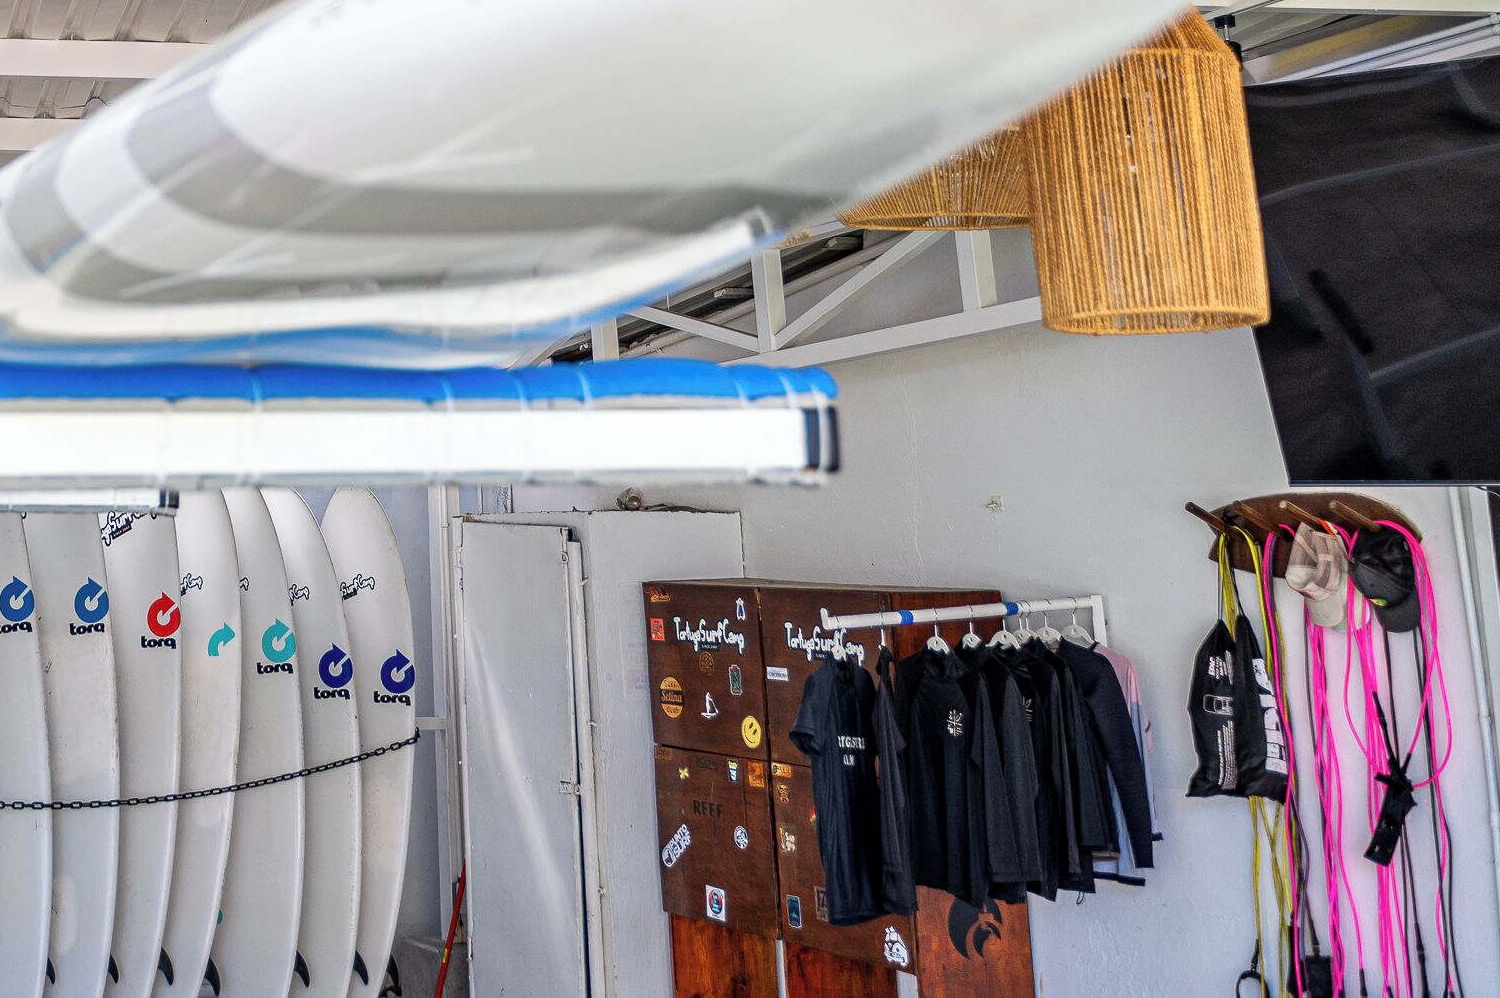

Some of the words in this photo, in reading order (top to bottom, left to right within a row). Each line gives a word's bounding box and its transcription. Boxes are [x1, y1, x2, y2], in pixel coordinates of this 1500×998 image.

[69, 622, 105, 636] torq
[141, 636, 177, 649] torq
[256, 662, 294, 675] torq
[313, 687, 350, 700] torq
[373, 691, 411, 706] torq
[660, 691, 683, 703] Selina
[693, 800, 724, 819] REEF
[669, 823, 688, 850] PUNTO
[673, 831, 692, 859] SURF
